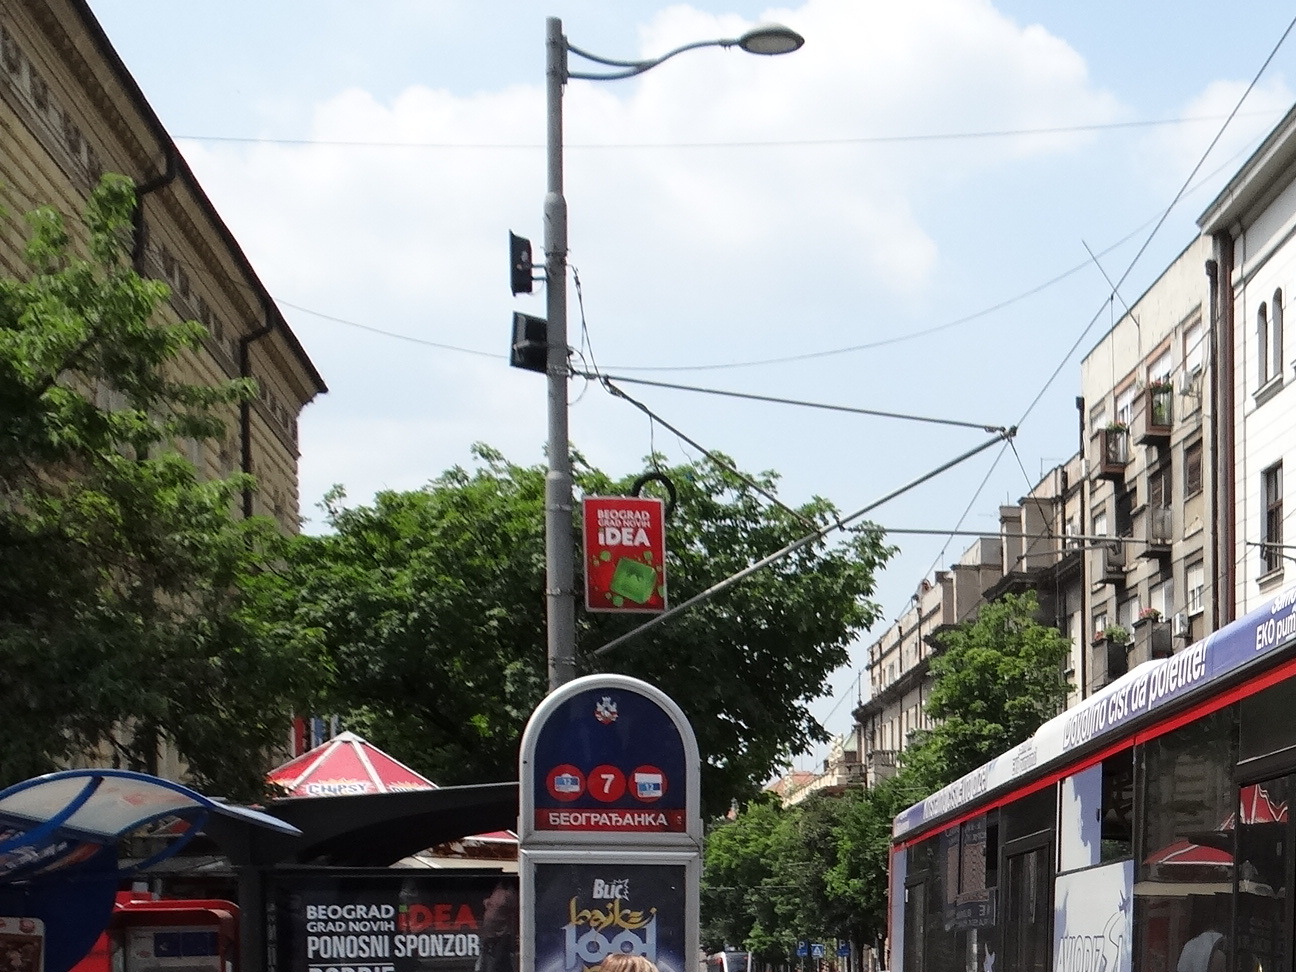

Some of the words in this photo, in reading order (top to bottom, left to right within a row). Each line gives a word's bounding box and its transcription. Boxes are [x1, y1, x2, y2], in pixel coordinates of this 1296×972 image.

[597, 509, 650, 520] BEOGRAD
[1256, 618, 1275, 650] EKO
[600, 773, 616, 794] 7
[548, 812, 669, 826] БЕОГРАЂАНКА
[306, 904, 395, 920] BEOGRAD
[306, 921, 346, 932] GRAD
[348, 920, 395, 932] NOVIH
[307, 935, 390, 959] PONOSNI
[394, 933, 480, 958] SPONZOR
